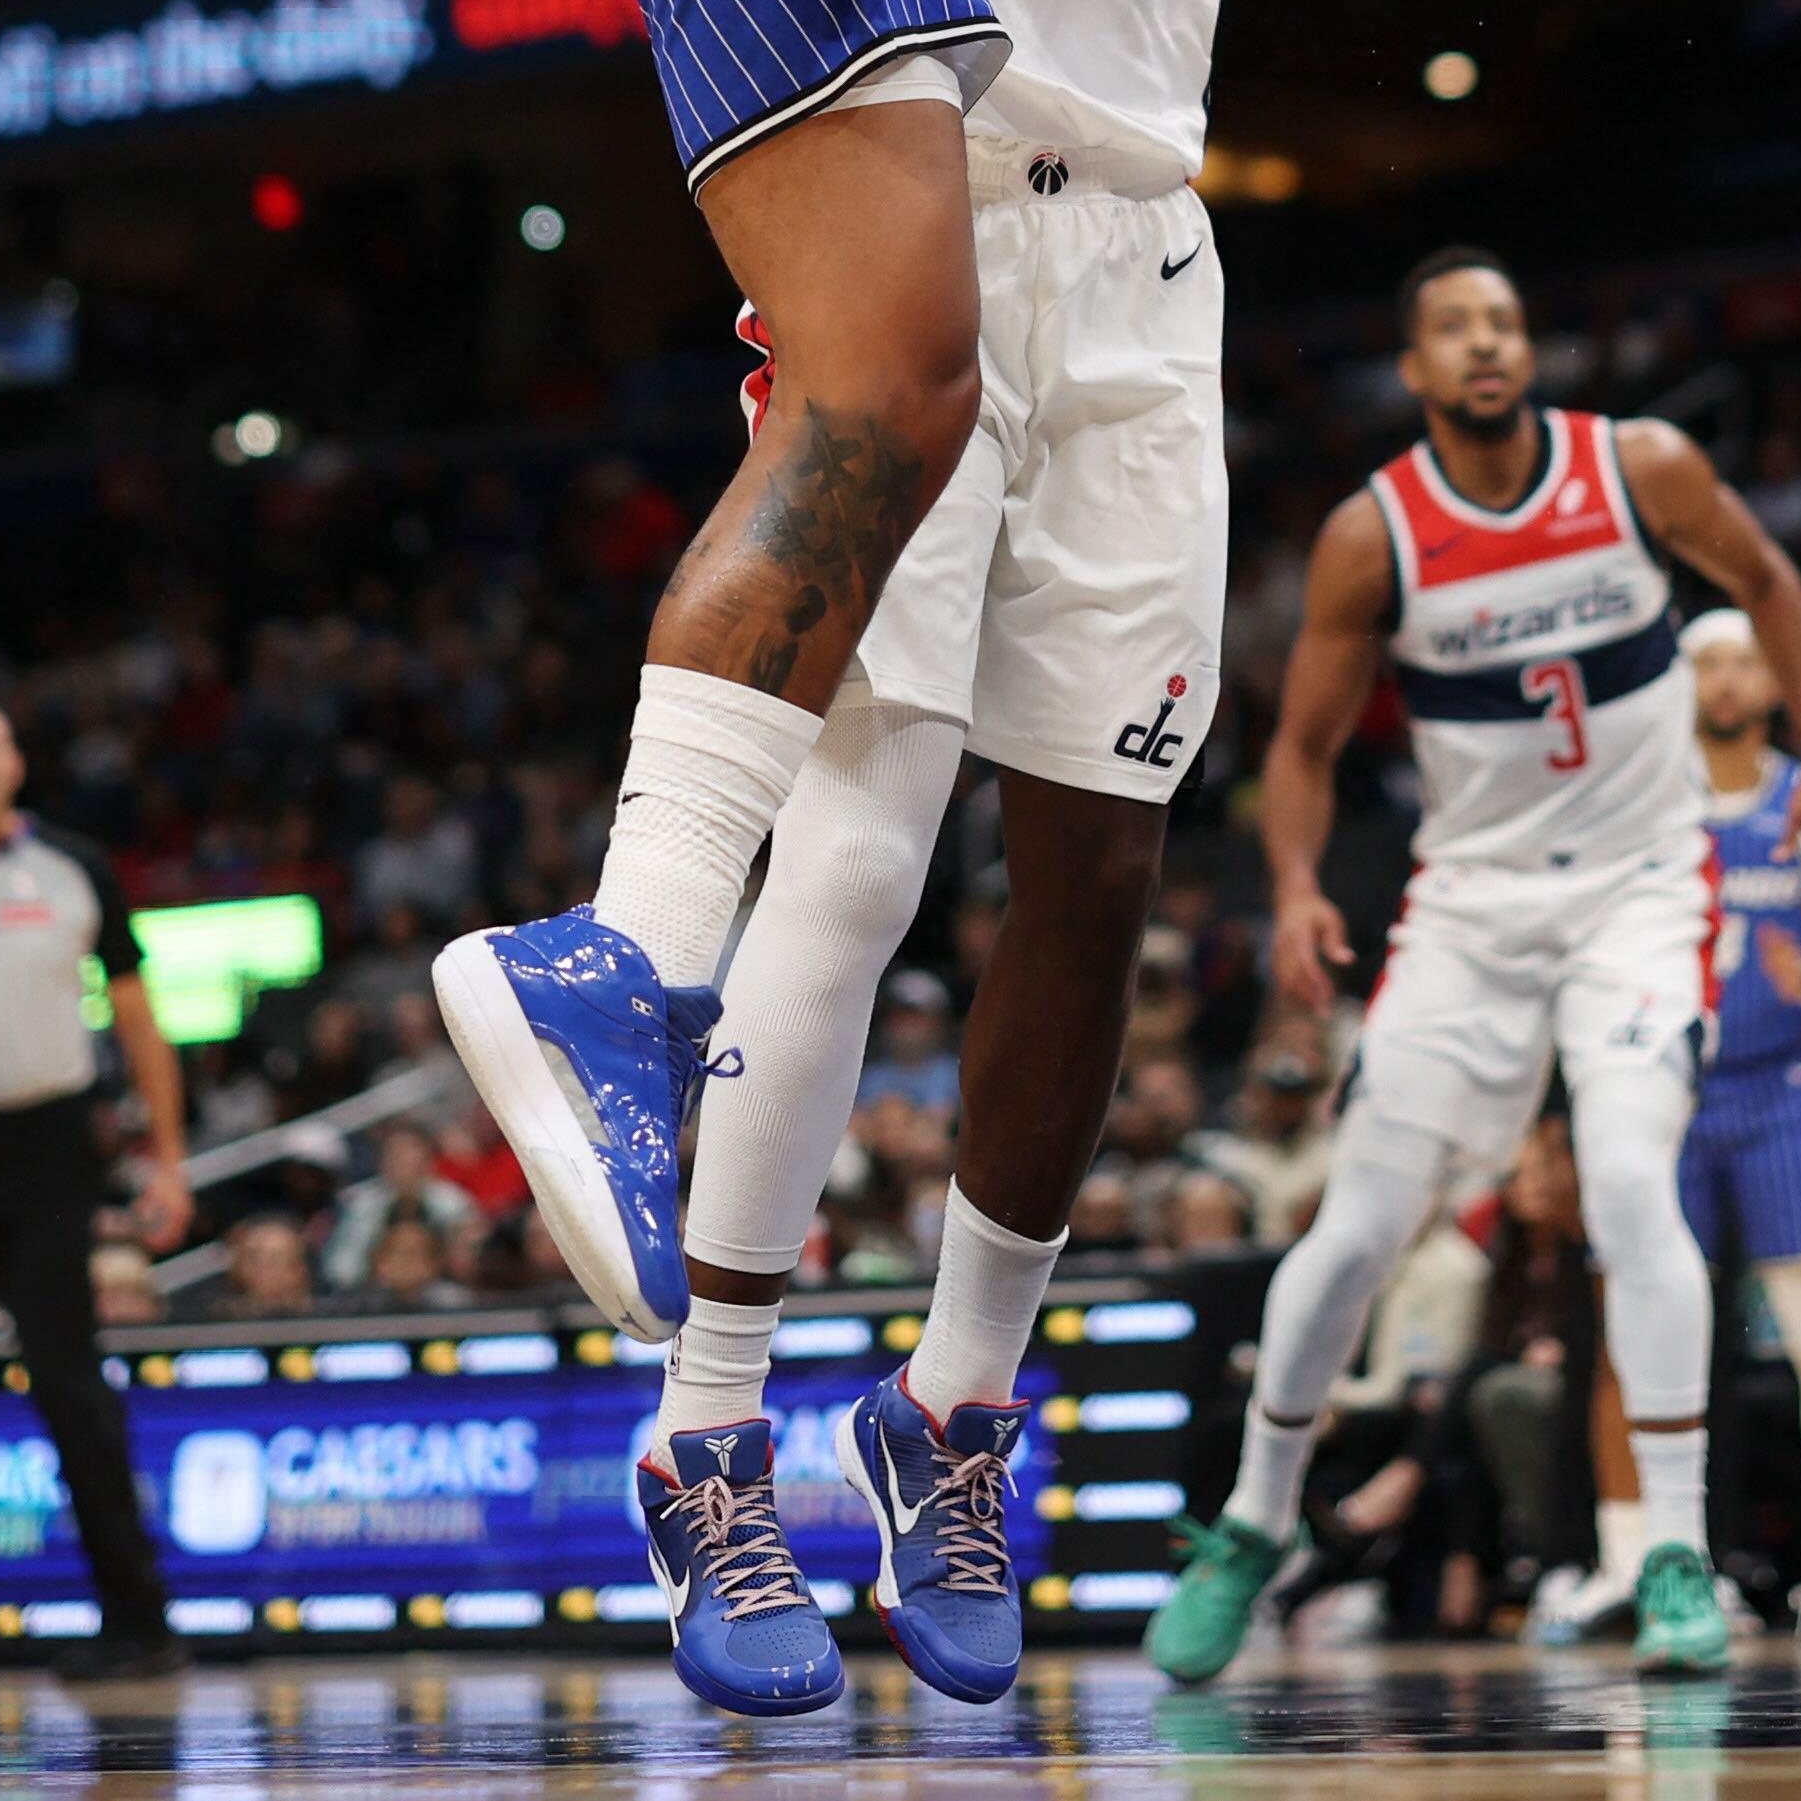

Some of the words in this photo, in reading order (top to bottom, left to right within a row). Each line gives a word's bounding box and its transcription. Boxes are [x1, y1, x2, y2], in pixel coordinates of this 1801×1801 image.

[1428, 570, 1635, 656] wizards
[1113, 695, 1185, 769] dc
[1520, 655, 1588, 774] 3
[266, 1416, 540, 1500] CAESARS
